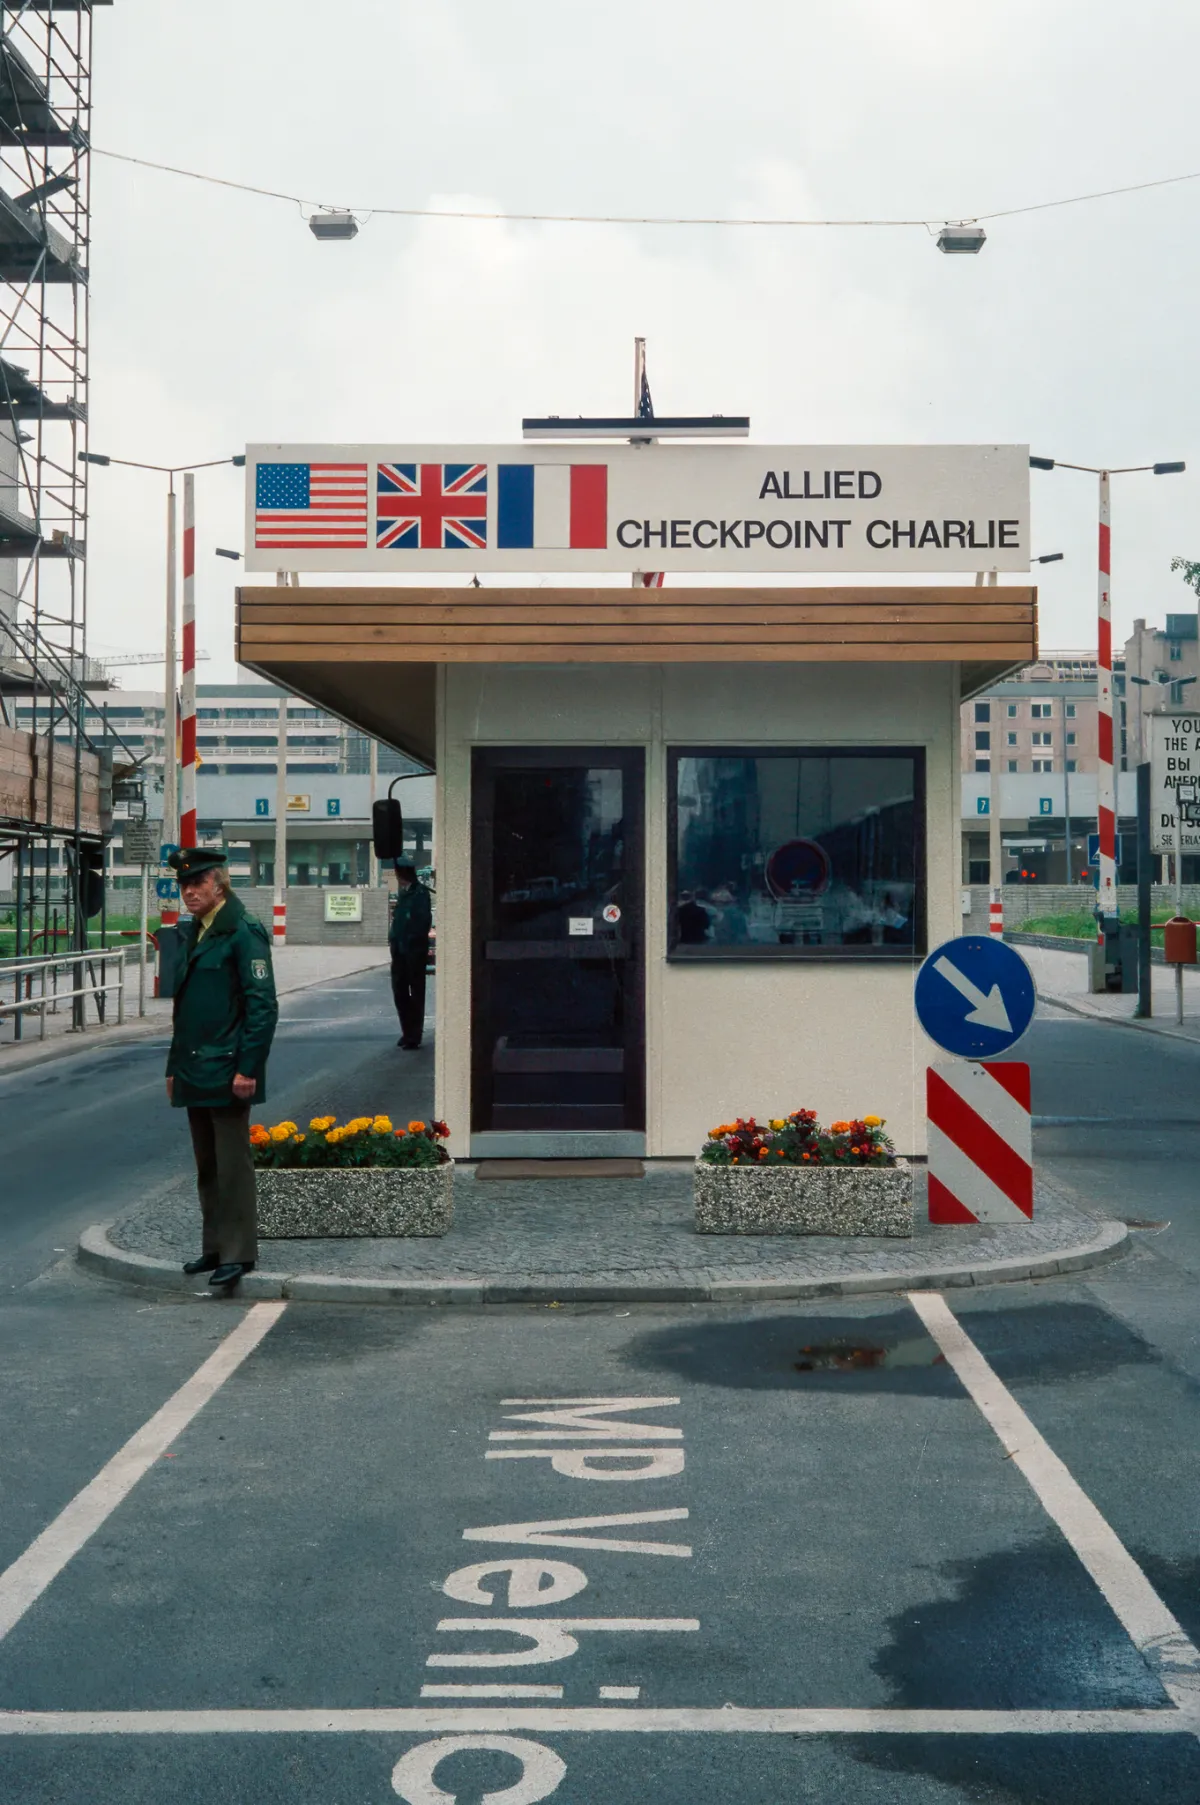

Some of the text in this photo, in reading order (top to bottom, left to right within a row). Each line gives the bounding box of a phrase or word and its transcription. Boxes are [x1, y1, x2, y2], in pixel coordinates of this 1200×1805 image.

[759, 471, 882, 499] ALLIED
[616, 519, 1020, 549] CHECKPOINT CHARLIE
[1172, 720, 1200, 733] YOU
[1164, 737, 1188, 751] THE
[980, 800, 986, 811] 7
[484, 1396, 685, 1481] MP
